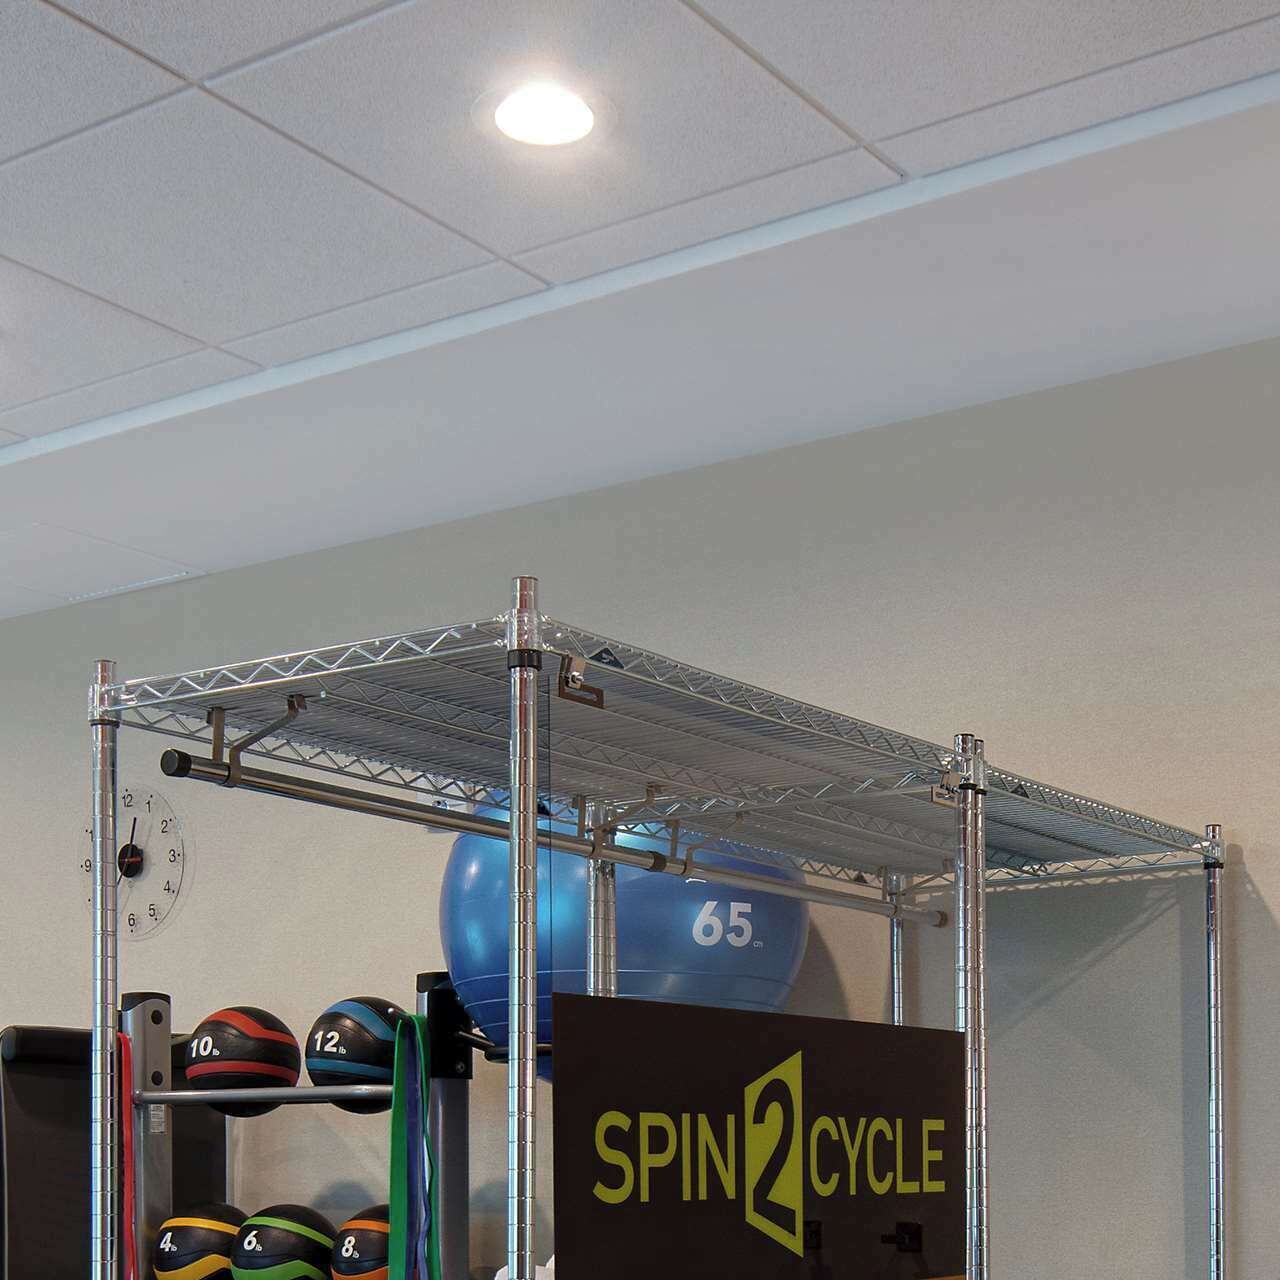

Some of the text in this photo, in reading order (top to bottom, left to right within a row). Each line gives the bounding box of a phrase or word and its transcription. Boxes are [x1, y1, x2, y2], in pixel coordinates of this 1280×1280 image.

[122, 794, 133, 808] 12
[145, 800, 151, 813] 1
[161, 819, 168, 833] 2
[168, 849, 176, 862] 3
[84, 859, 92, 872] 9
[163, 880, 170, 893] 4
[148, 904, 156, 917] 5
[128, 913, 136, 926] 6
[692, 900, 753, 947] 65
[593, 1110, 736, 1204] SPIN
[810, 1115, 945, 1197] CYCLE
